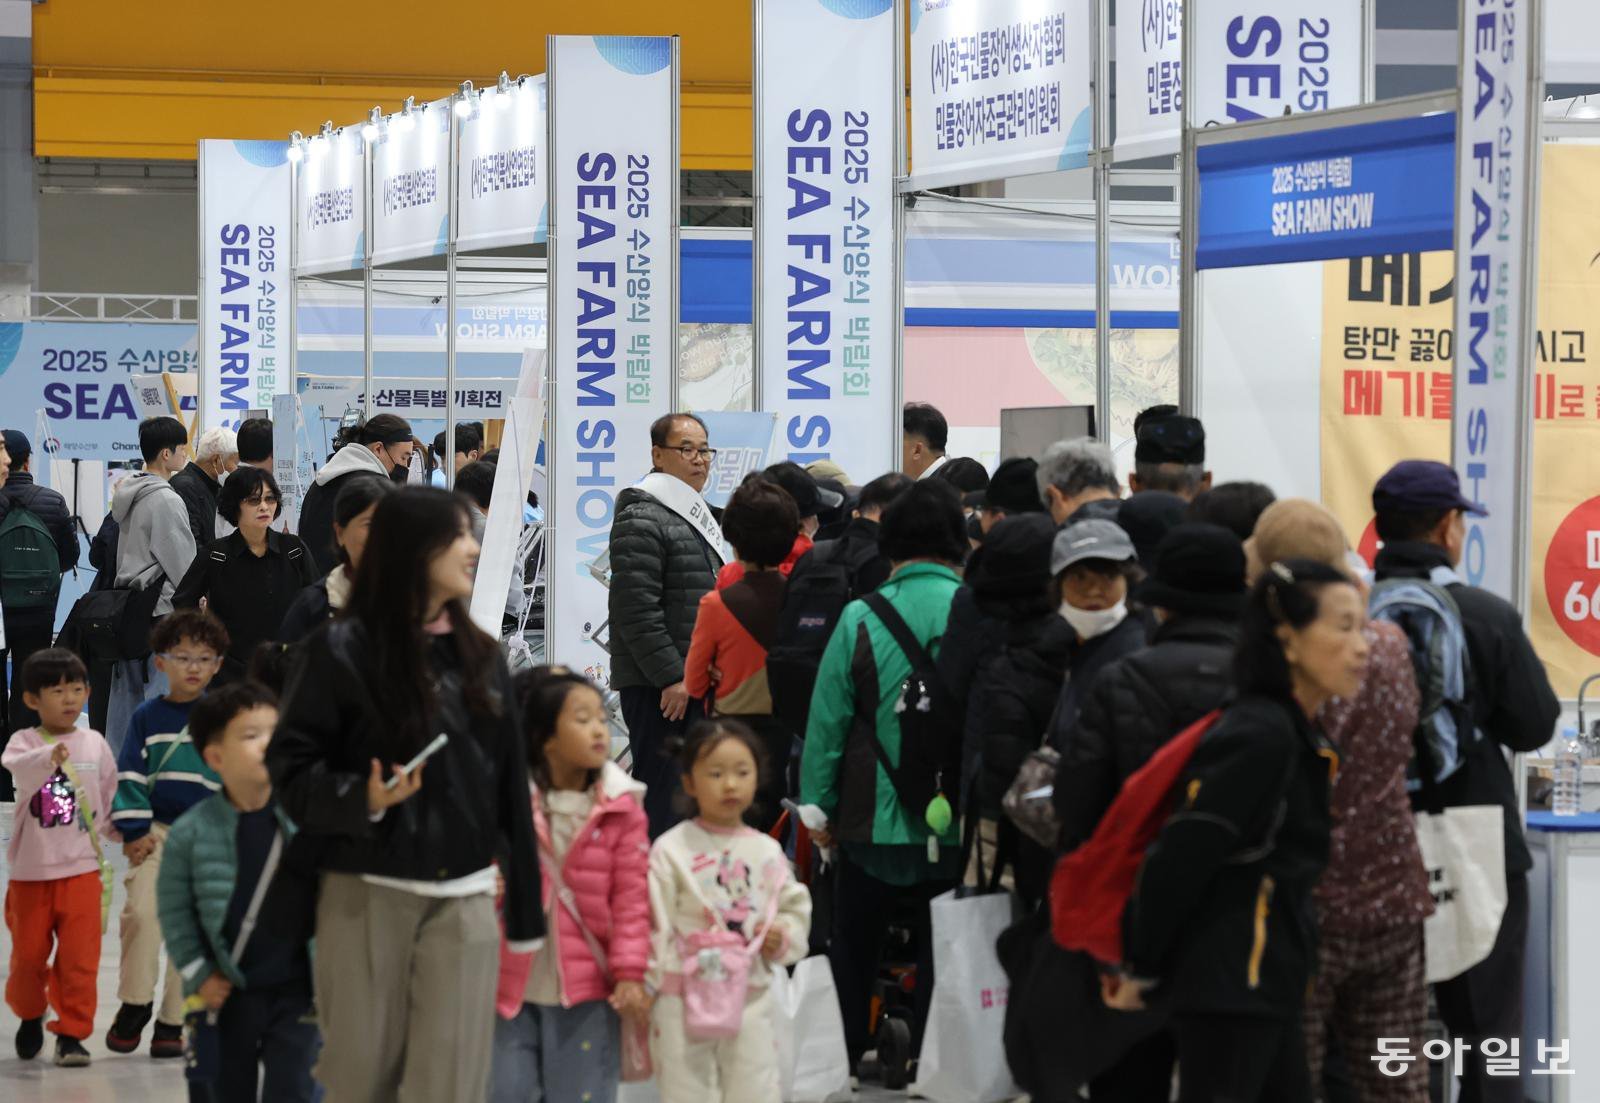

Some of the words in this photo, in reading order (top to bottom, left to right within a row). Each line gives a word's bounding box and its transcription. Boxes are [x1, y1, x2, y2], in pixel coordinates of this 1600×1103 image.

[931, 12, 1066, 94] (사)한국민물장어생산자협회
[1142, 0, 1182, 52] (사)한
[1474, 0, 1496, 120] EA
[1297, 17, 1329, 112] 2025
[844, 111, 869, 184] 2025
[935, 80, 1061, 150] 민물장어자조금관리위원회
[576, 152, 617, 249] SEA
[627, 154, 649, 219] 2025
[787, 108, 832, 220] SEA
[1272, 167, 1293, 194] 2025
[258, 225, 275, 273] 2025
[843, 196, 871, 304] 수산양식
[1272, 200, 1296, 237] SEA
[1296, 196, 1332, 235] FARM
[1332, 193, 1374, 232] SHOW
[220, 224, 250, 295] SEA
[626, 229, 650, 322] 수산양식
[1468, 142, 1493, 385] FARM
[257, 280, 276, 349] 수산양식
[576, 261, 616, 407] FARM
[787, 234, 831, 400] FARM
[1344, 326, 1400, 362] 탕만
[43, 348, 107, 372] 2025
[220, 303, 250, 410] FARM
[257, 357, 276, 408] 박람회
[625, 334, 650, 404] 박람회
[842, 317, 871, 397] 박람회
[43, 382, 137, 420] SEA
[787, 414, 831, 464] S
[576, 419, 616, 578] SHOW
[1465, 407, 1488, 587] SHO
